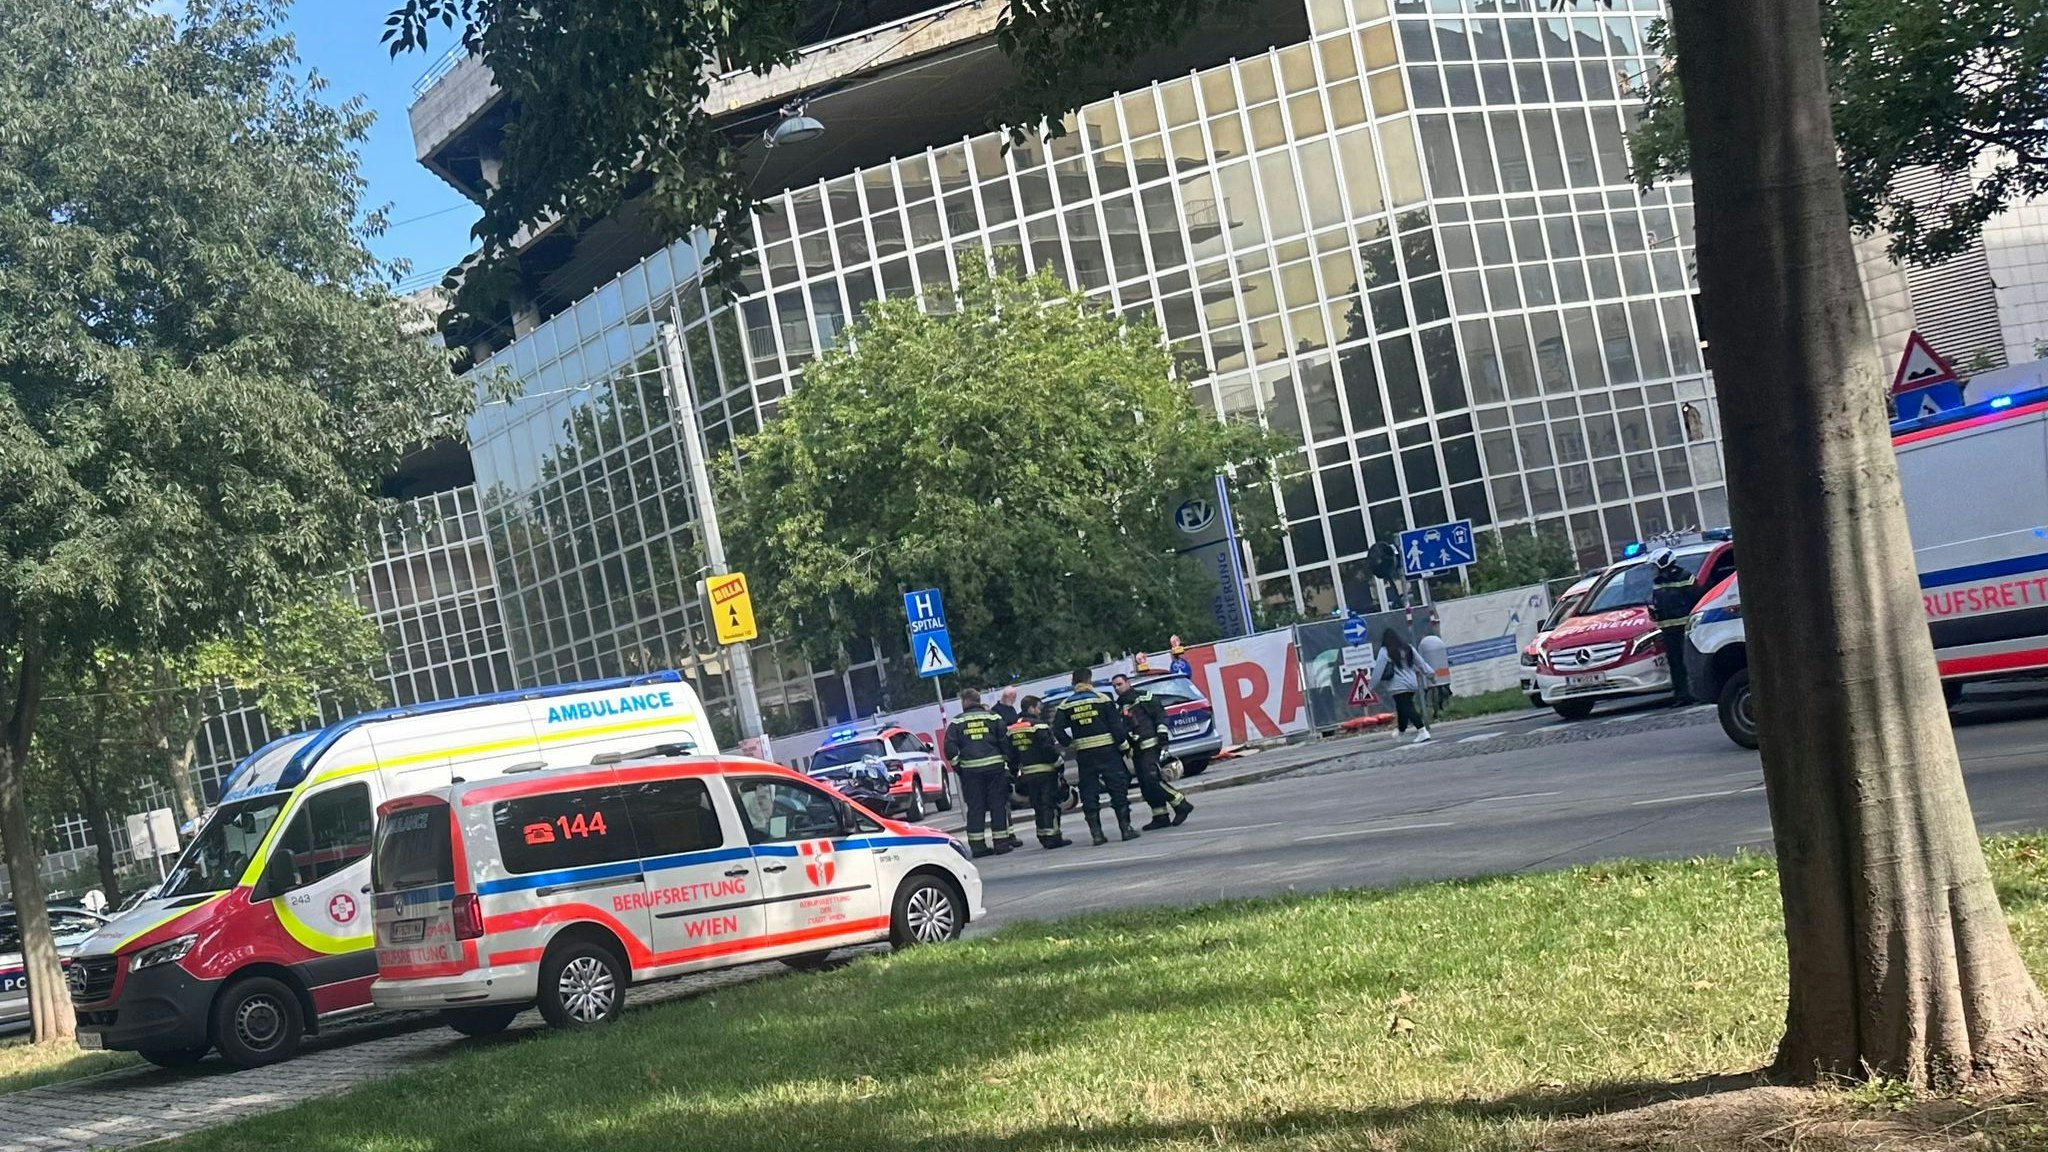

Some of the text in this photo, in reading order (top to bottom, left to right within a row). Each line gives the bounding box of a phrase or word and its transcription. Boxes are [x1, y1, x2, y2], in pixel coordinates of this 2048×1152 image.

[713, 580, 743, 603] BILLA
[1217, 552, 1241, 637] SICHERUNG
[1923, 577, 2048, 617] RUFSRETT
[915, 593, 933, 620] H
[911, 617, 944, 634] SPITAL
[1652, 656, 1666, 667] 12
[548, 692, 674, 724] AMBULANCE
[1173, 715, 1198, 726] POLIZEI
[556, 811, 607, 840] 144
[291, 894, 311, 906] 243
[612, 878, 746, 912] BERUFSRETTUNG
[684, 915, 738, 939] WIEN
[4, 976, 27, 991] PO
